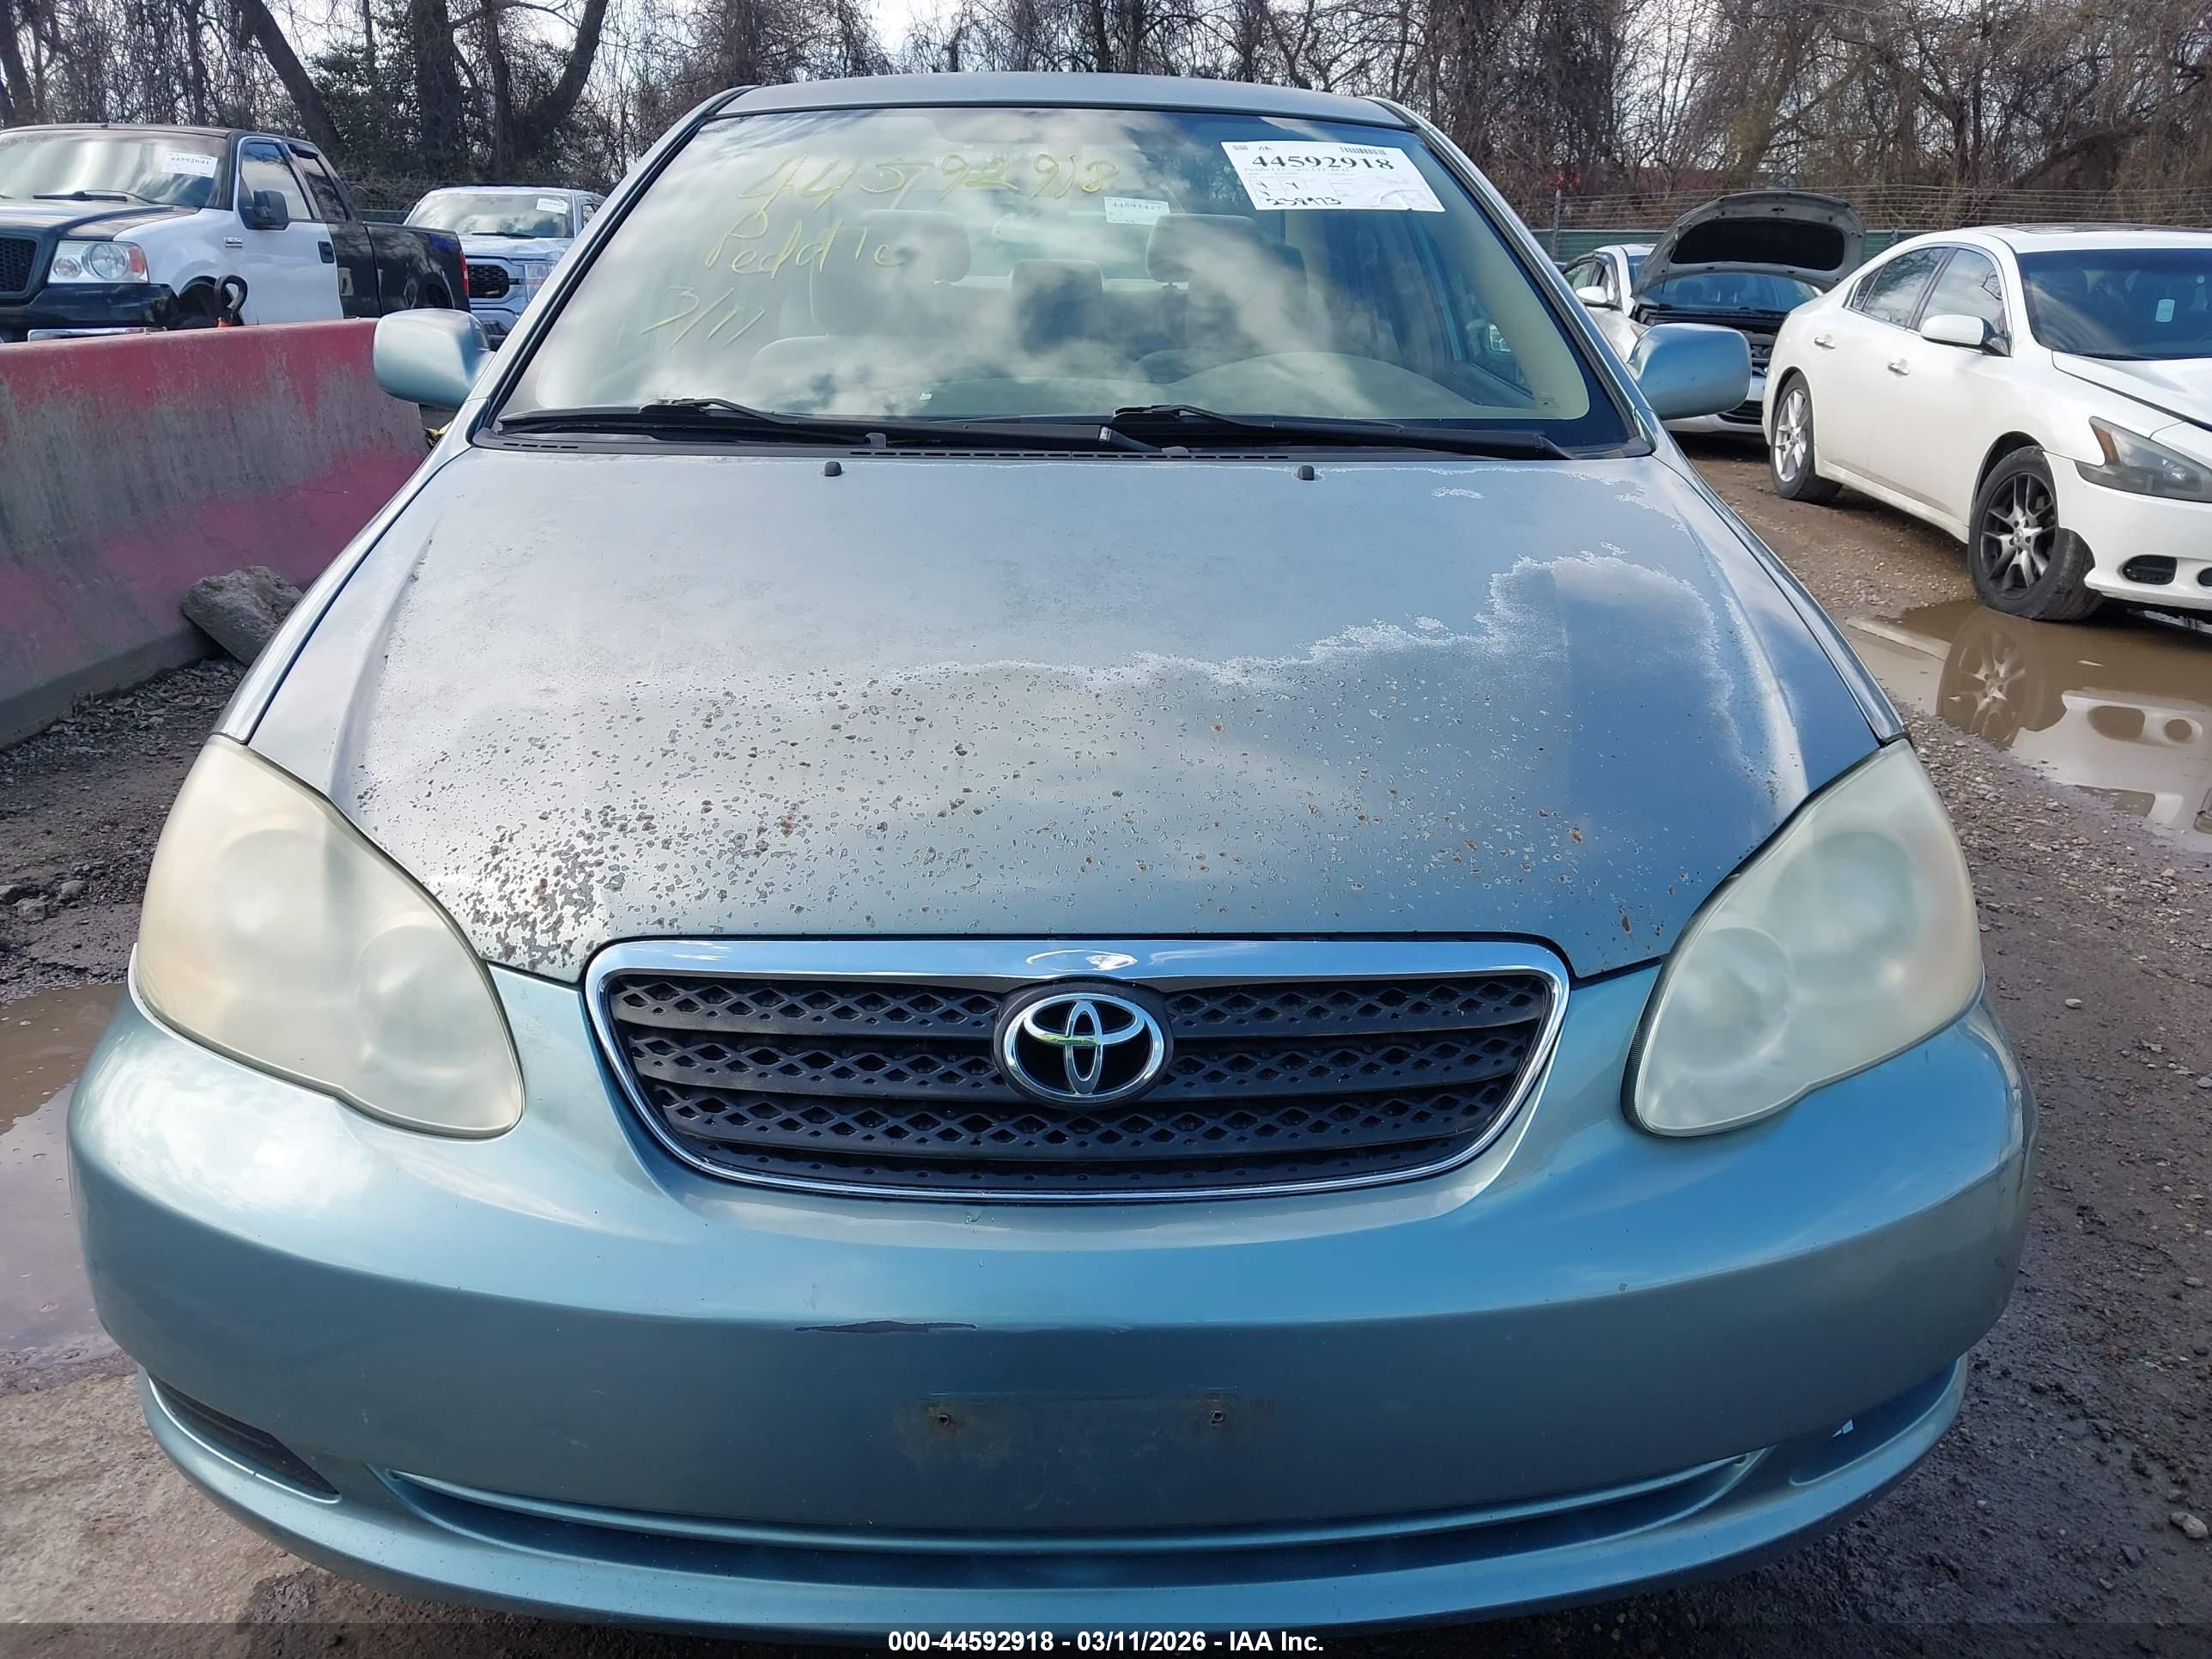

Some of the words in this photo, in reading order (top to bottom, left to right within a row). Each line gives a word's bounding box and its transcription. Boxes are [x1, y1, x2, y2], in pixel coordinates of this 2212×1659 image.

[737, 152, 1119, 219] 44592918
[1252, 155, 1395, 170] 44592918
[704, 210, 907, 280] Peddle
[639, 286, 766, 350] 3/11
